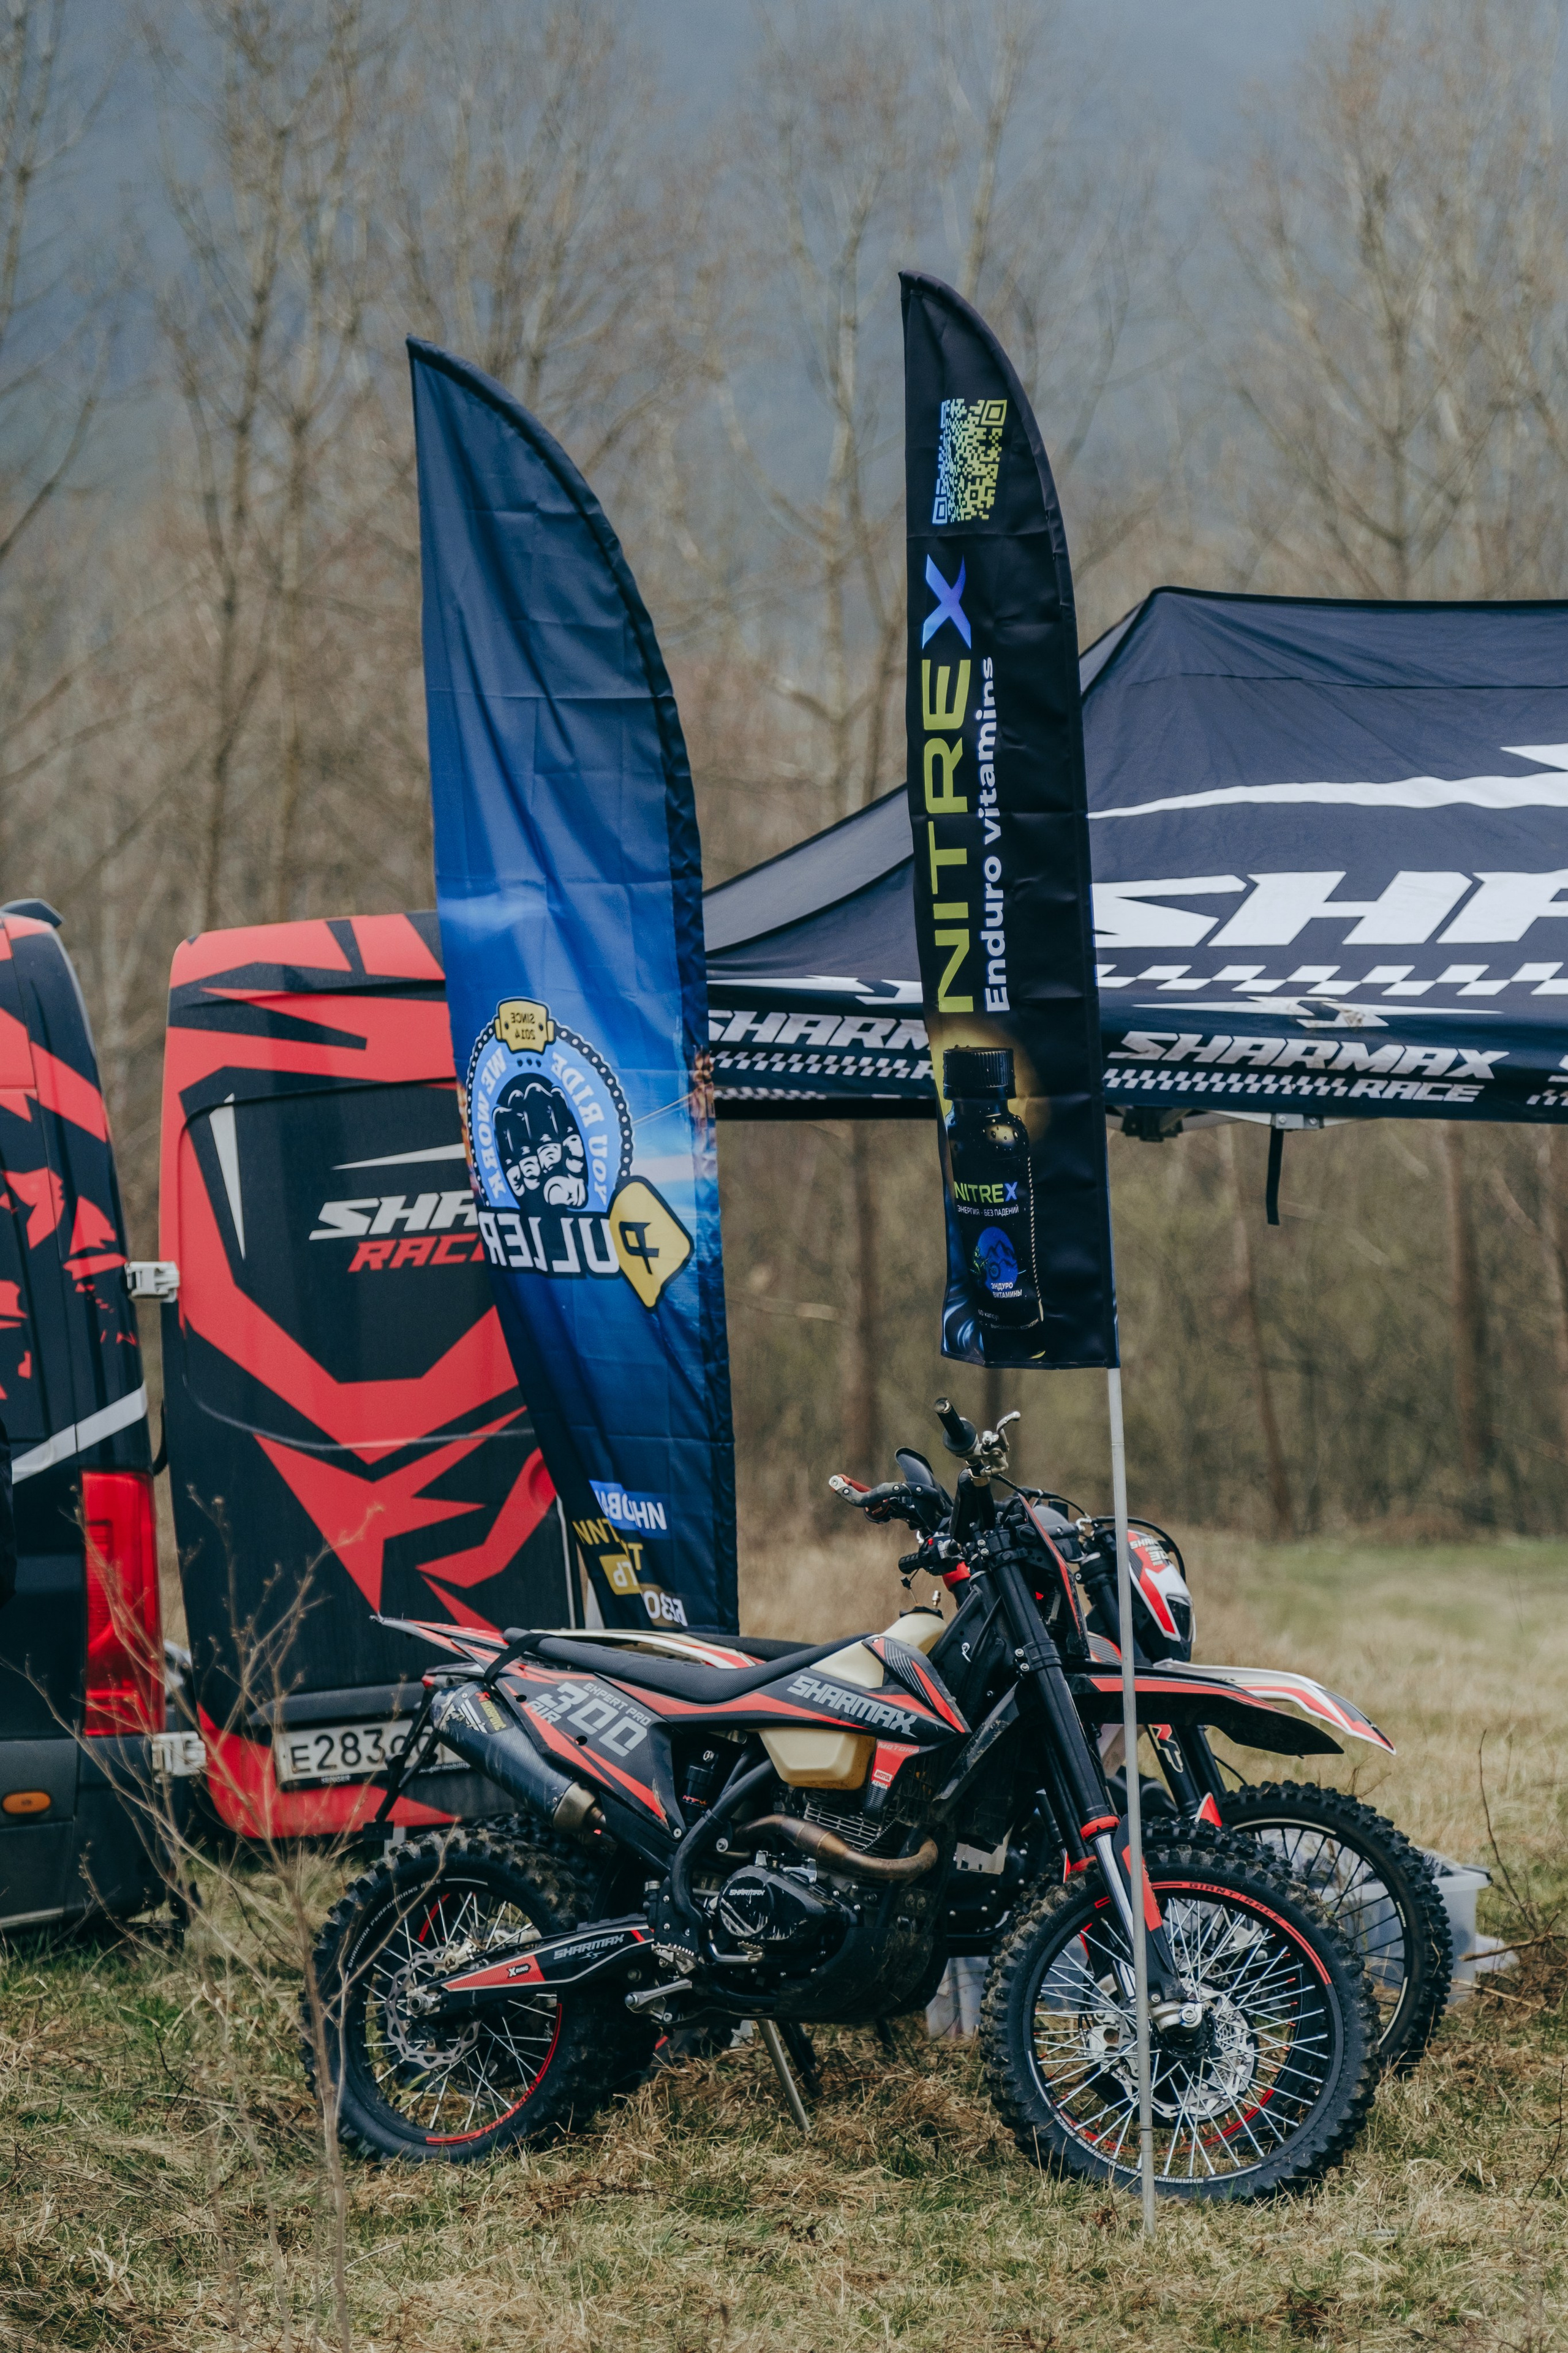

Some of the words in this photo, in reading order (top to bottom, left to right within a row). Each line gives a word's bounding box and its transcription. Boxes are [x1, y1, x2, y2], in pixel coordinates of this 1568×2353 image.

[975, 657, 1001, 845] vitamins
[922, 554, 974, 1012] NITREX
[981, 856, 1010, 1011] Enduro
[1107, 1030, 1509, 1079] SHARMAX
[1348, 1077, 1485, 1103] RACE
[954, 1181, 1018, 1203] NITREX
[957, 1204, 980, 1215] ЭНЕРГИЯ
[994, 1204, 1019, 1217] ПАДЕНИЙ
[990, 1282, 1014, 1291] ЭНДУРО
[992, 1290, 1022, 1299] ВИТАМИНЫ
[524, 1701, 562, 1724] AIR
[582, 1682, 627, 1713] EXPERT
[627, 1708, 652, 1726] PRO
[786, 1675, 918, 1738] SHARMAX
[536, 1682, 648, 1758] 300
[878, 1743, 919, 1754] MOTORS
[872, 1780, 888, 1789] KENDA
[875, 1771, 891, 1780] MOTUL
[1188, 1883, 1236, 1897] GIANT
[1245, 1898, 1283, 1922] RACE
[553, 1933, 625, 1960] SHARMAX
[1054, 2113, 1076, 2137] RACE
[1076, 2137, 1141, 2177] ERFORMANS
